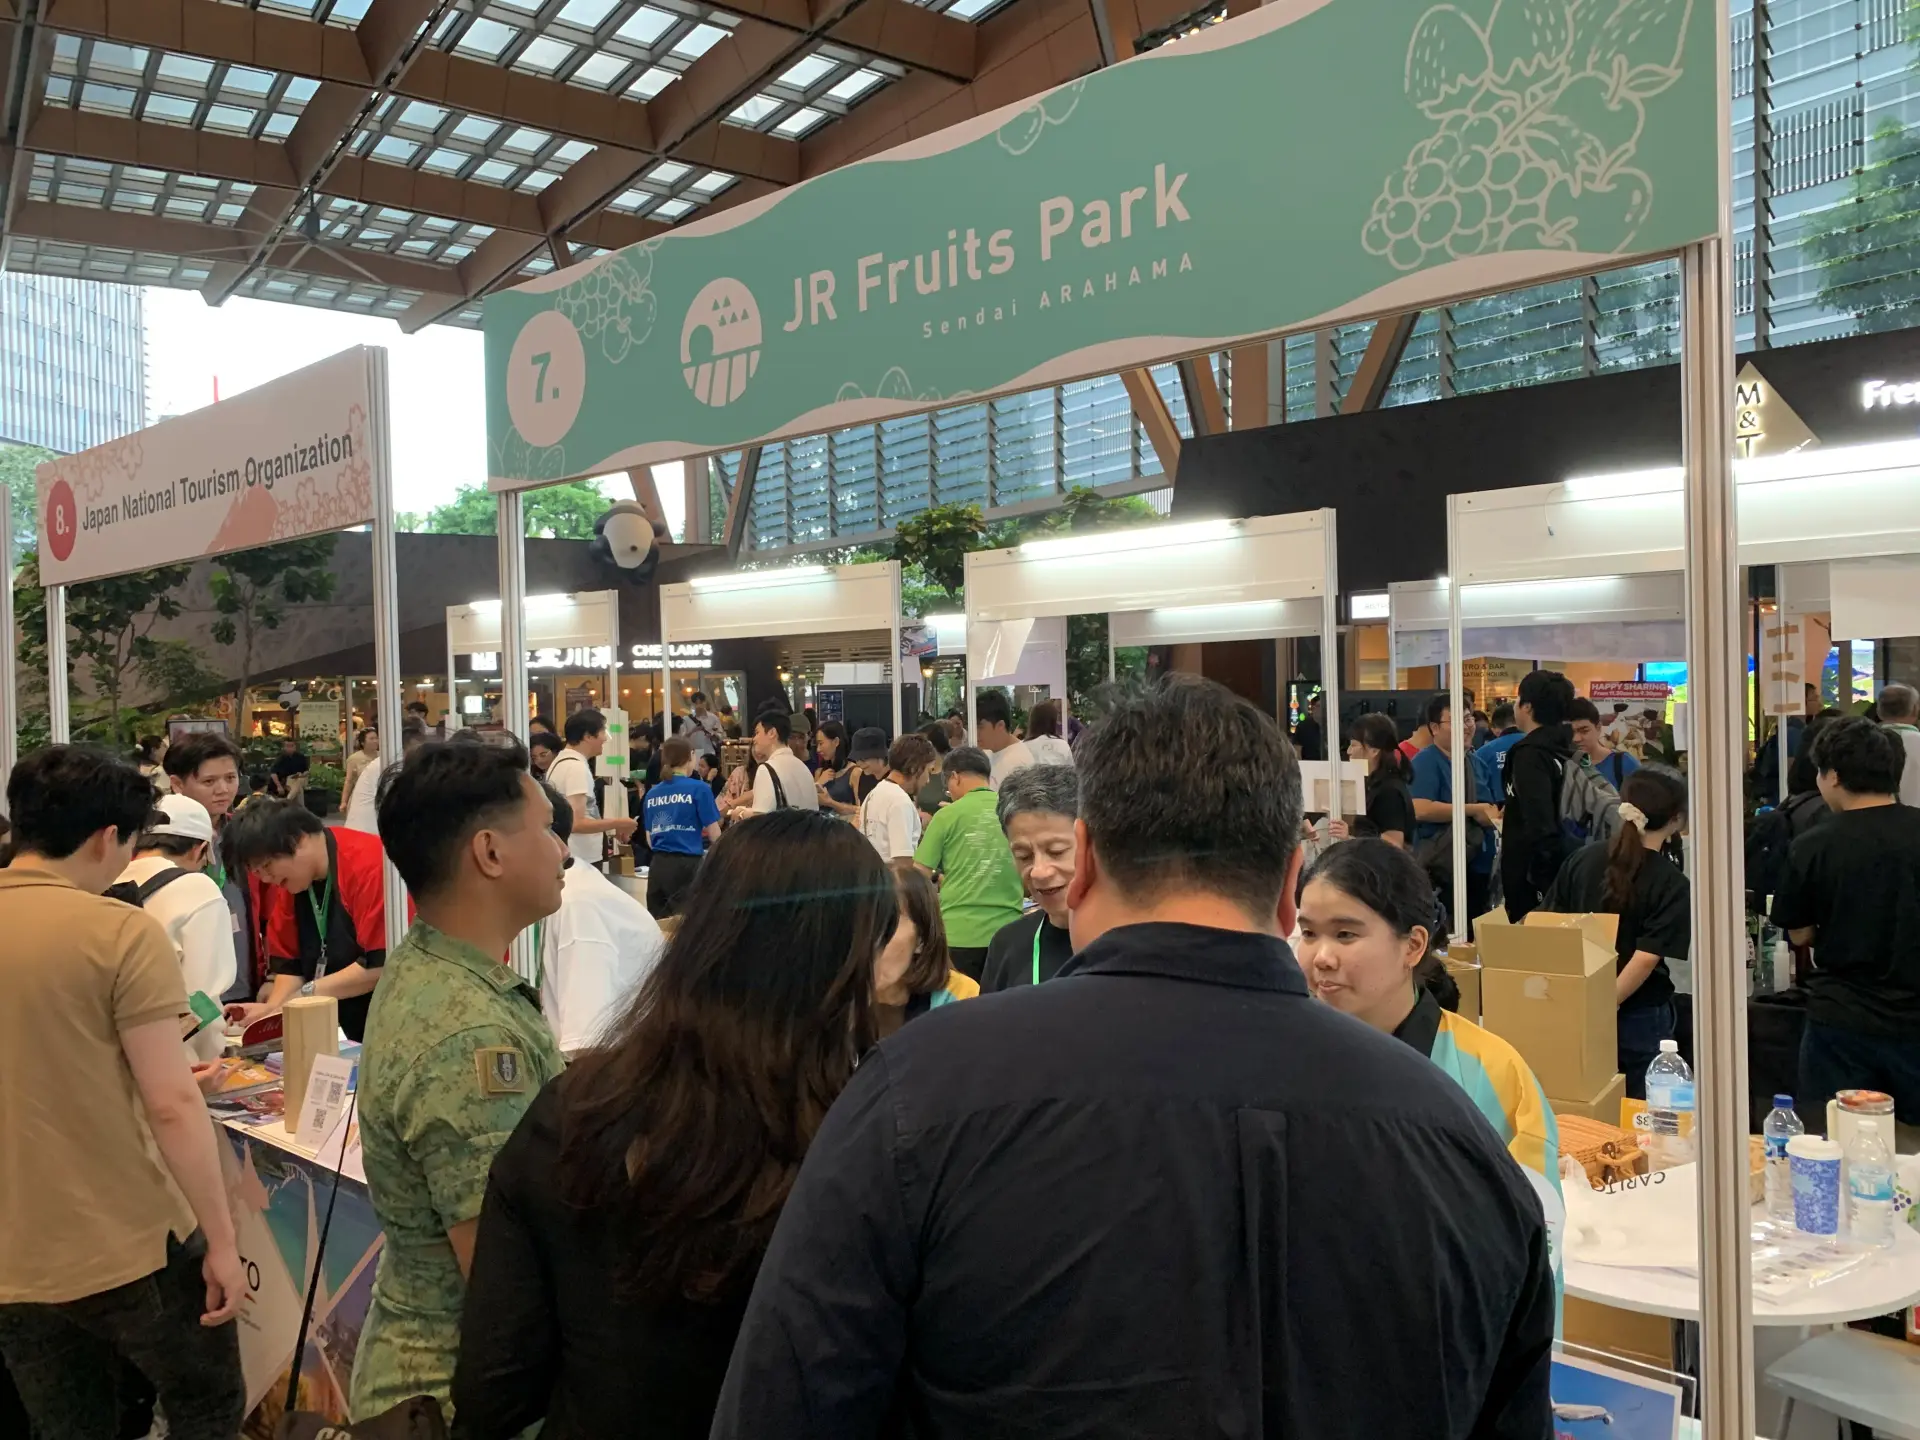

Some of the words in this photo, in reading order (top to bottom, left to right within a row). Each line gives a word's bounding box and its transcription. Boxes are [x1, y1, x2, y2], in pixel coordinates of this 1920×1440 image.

[783, 269, 838, 333] JR
[857, 227, 1015, 312] Fruits
[1039, 162, 1191, 261] Park
[922, 299, 1018, 338] Sendai
[1039, 252, 1194, 309] ARAHAMA
[530, 351, 560, 403] 7.
[1736, 382, 1762, 406] M
[1739, 411, 1756, 429] &
[1736, 432, 1763, 459] T
[82, 504, 119, 534] Japan
[122, 481, 177, 519] National
[179, 467, 240, 504] Tourism
[245, 433, 353, 490] Organization
[55, 504, 70, 535] 8.
[632, 644, 663, 657] CHE
[668, 643, 713, 656] LAM'S
[1592, 683, 1623, 691] HAPPY
[1624, 682, 1667, 691] SHARING
[647, 793, 693, 808] FUKUOKA
